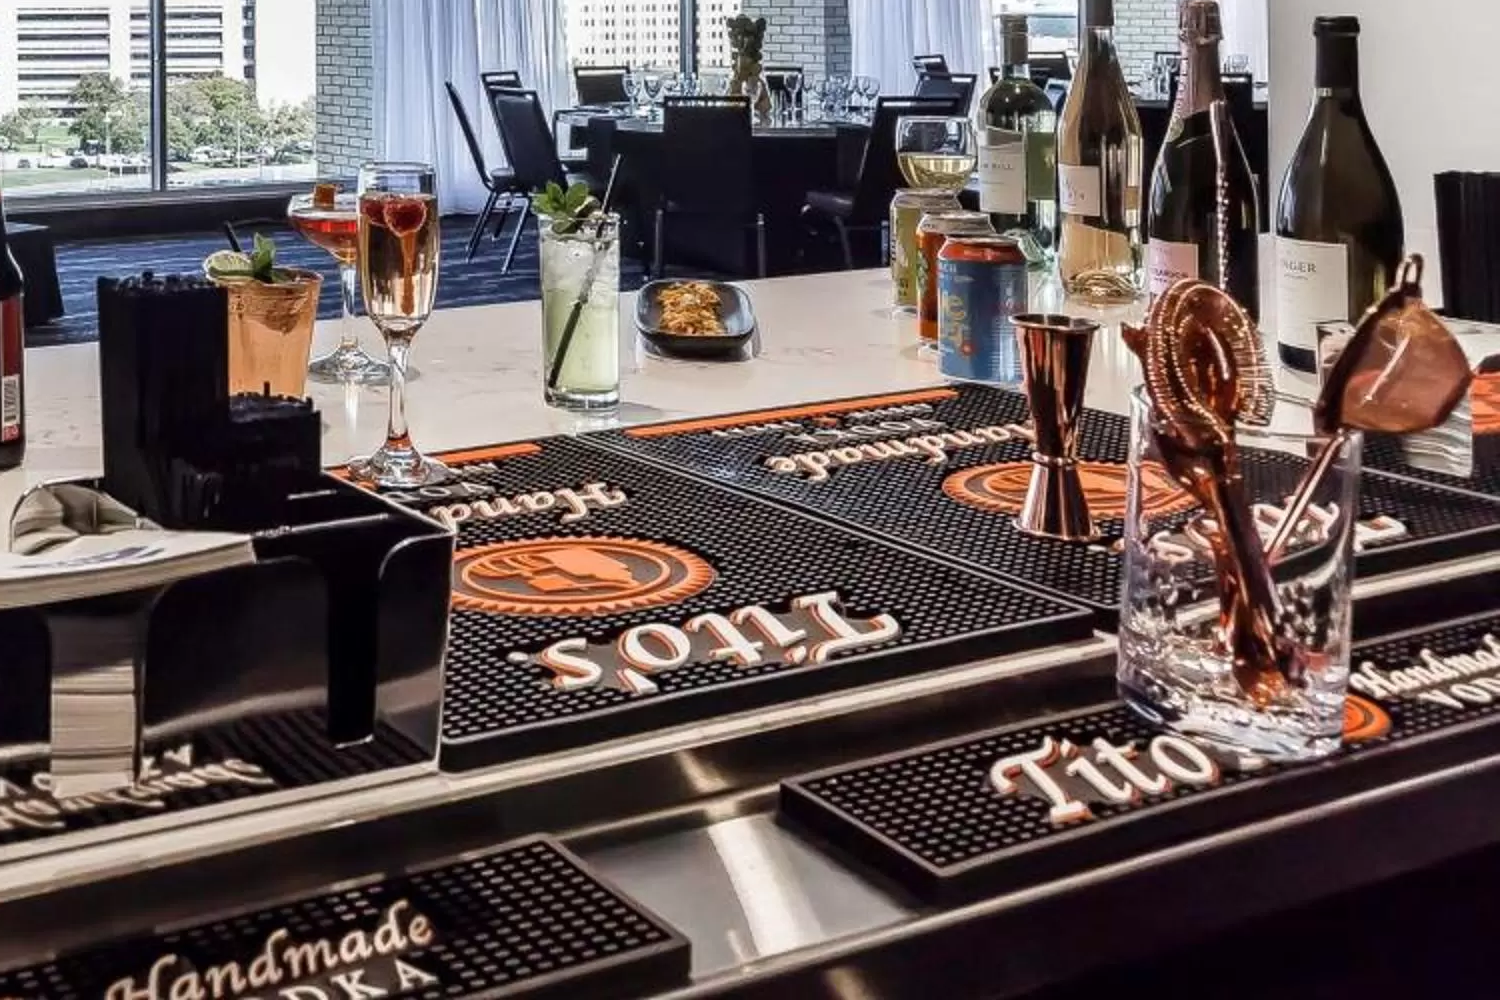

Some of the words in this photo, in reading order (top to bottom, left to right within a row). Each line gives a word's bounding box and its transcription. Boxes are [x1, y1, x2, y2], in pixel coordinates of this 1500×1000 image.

[429, 482, 628, 526] Hand
[540, 591, 900, 695] Tito's
[1349, 633, 1500, 699] Handma
[990, 735, 1268, 823] Tito
[103, 897, 436, 1000] Handmade
[244, 958, 438, 1000] DKA
